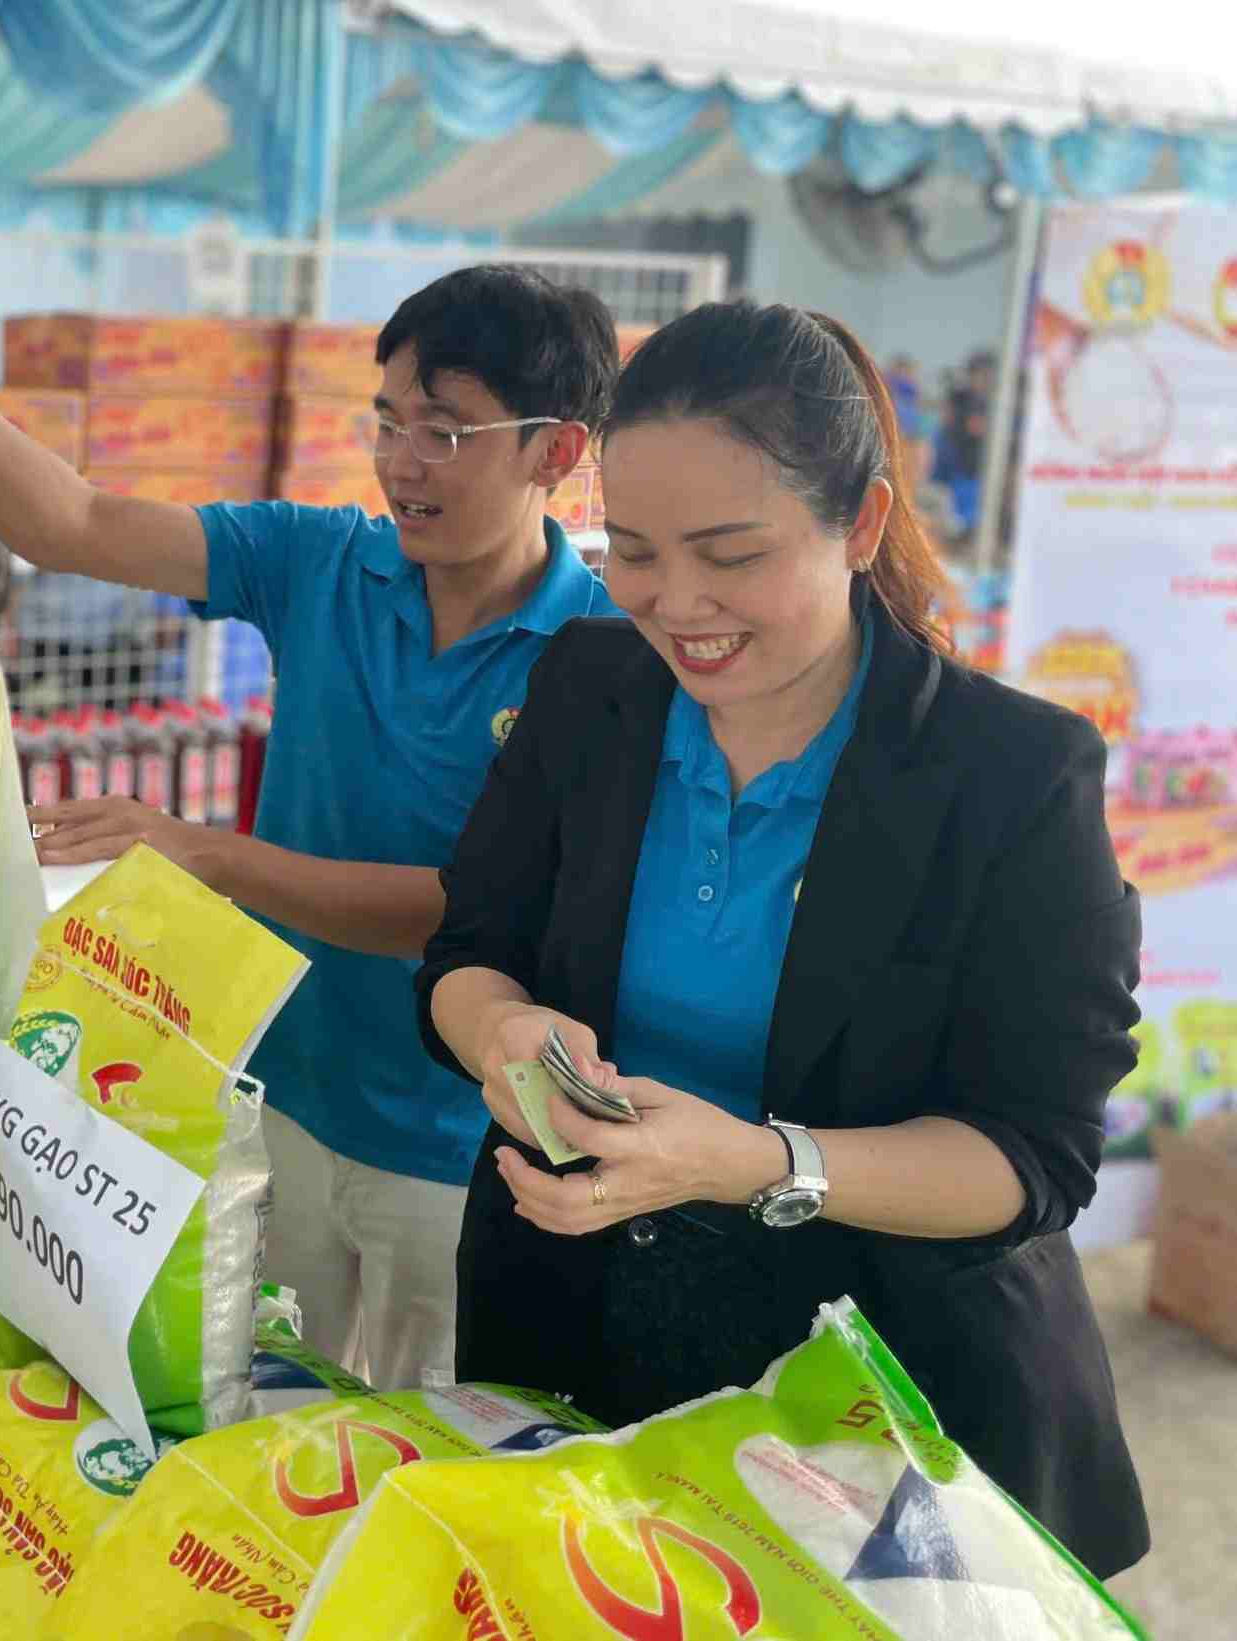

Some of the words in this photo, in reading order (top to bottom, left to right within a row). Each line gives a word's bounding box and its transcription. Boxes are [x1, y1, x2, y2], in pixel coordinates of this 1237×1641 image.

[21, 1125, 79, 1180] GẠO
[75, 1163, 118, 1207] ST
[112, 1190, 157, 1236] 25
